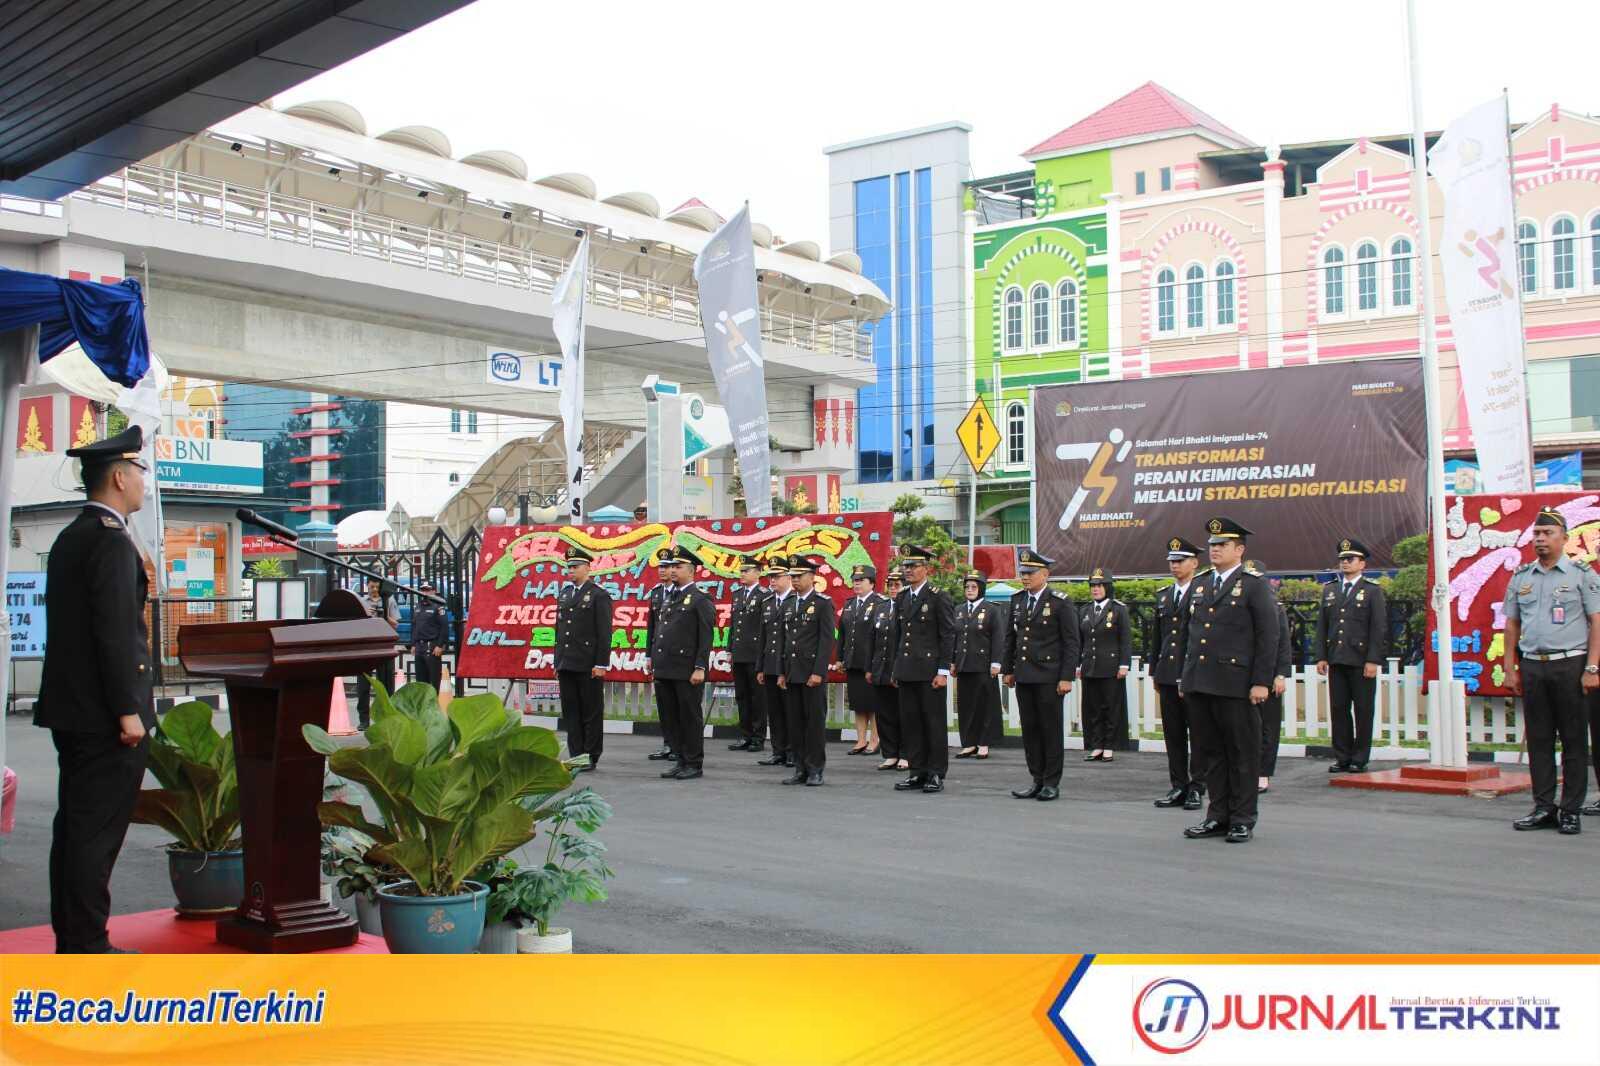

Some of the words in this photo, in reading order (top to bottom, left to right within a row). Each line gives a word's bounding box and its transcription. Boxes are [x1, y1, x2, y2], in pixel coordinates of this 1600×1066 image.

[1136, 438, 1167, 448] Selamat
[1168, 436, 1184, 446] Hari
[1186, 435, 1211, 445] Bhakti
[1212, 432, 1244, 444] Imigrasi
[1246, 431, 1268, 441] ke-74
[176, 440, 210, 461] BNI
[1135, 447, 1265, 467] TRANSFORMASI
[156, 466, 181, 477] ATM
[1134, 470, 1188, 486] PERAN
[1190, 464, 1316, 483] KEIMIGRASIAN
[1134, 487, 1203, 504] MELALUI
[1205, 484, 1286, 501] STRATEGI
[1288, 478, 1407, 498] DIGITALISASI
[841, 498, 859, 511] BSI
[1080, 513, 1100, 521] HARI
[1101, 511, 1133, 521] BHAKTI
[17, 613, 31, 626] 74
